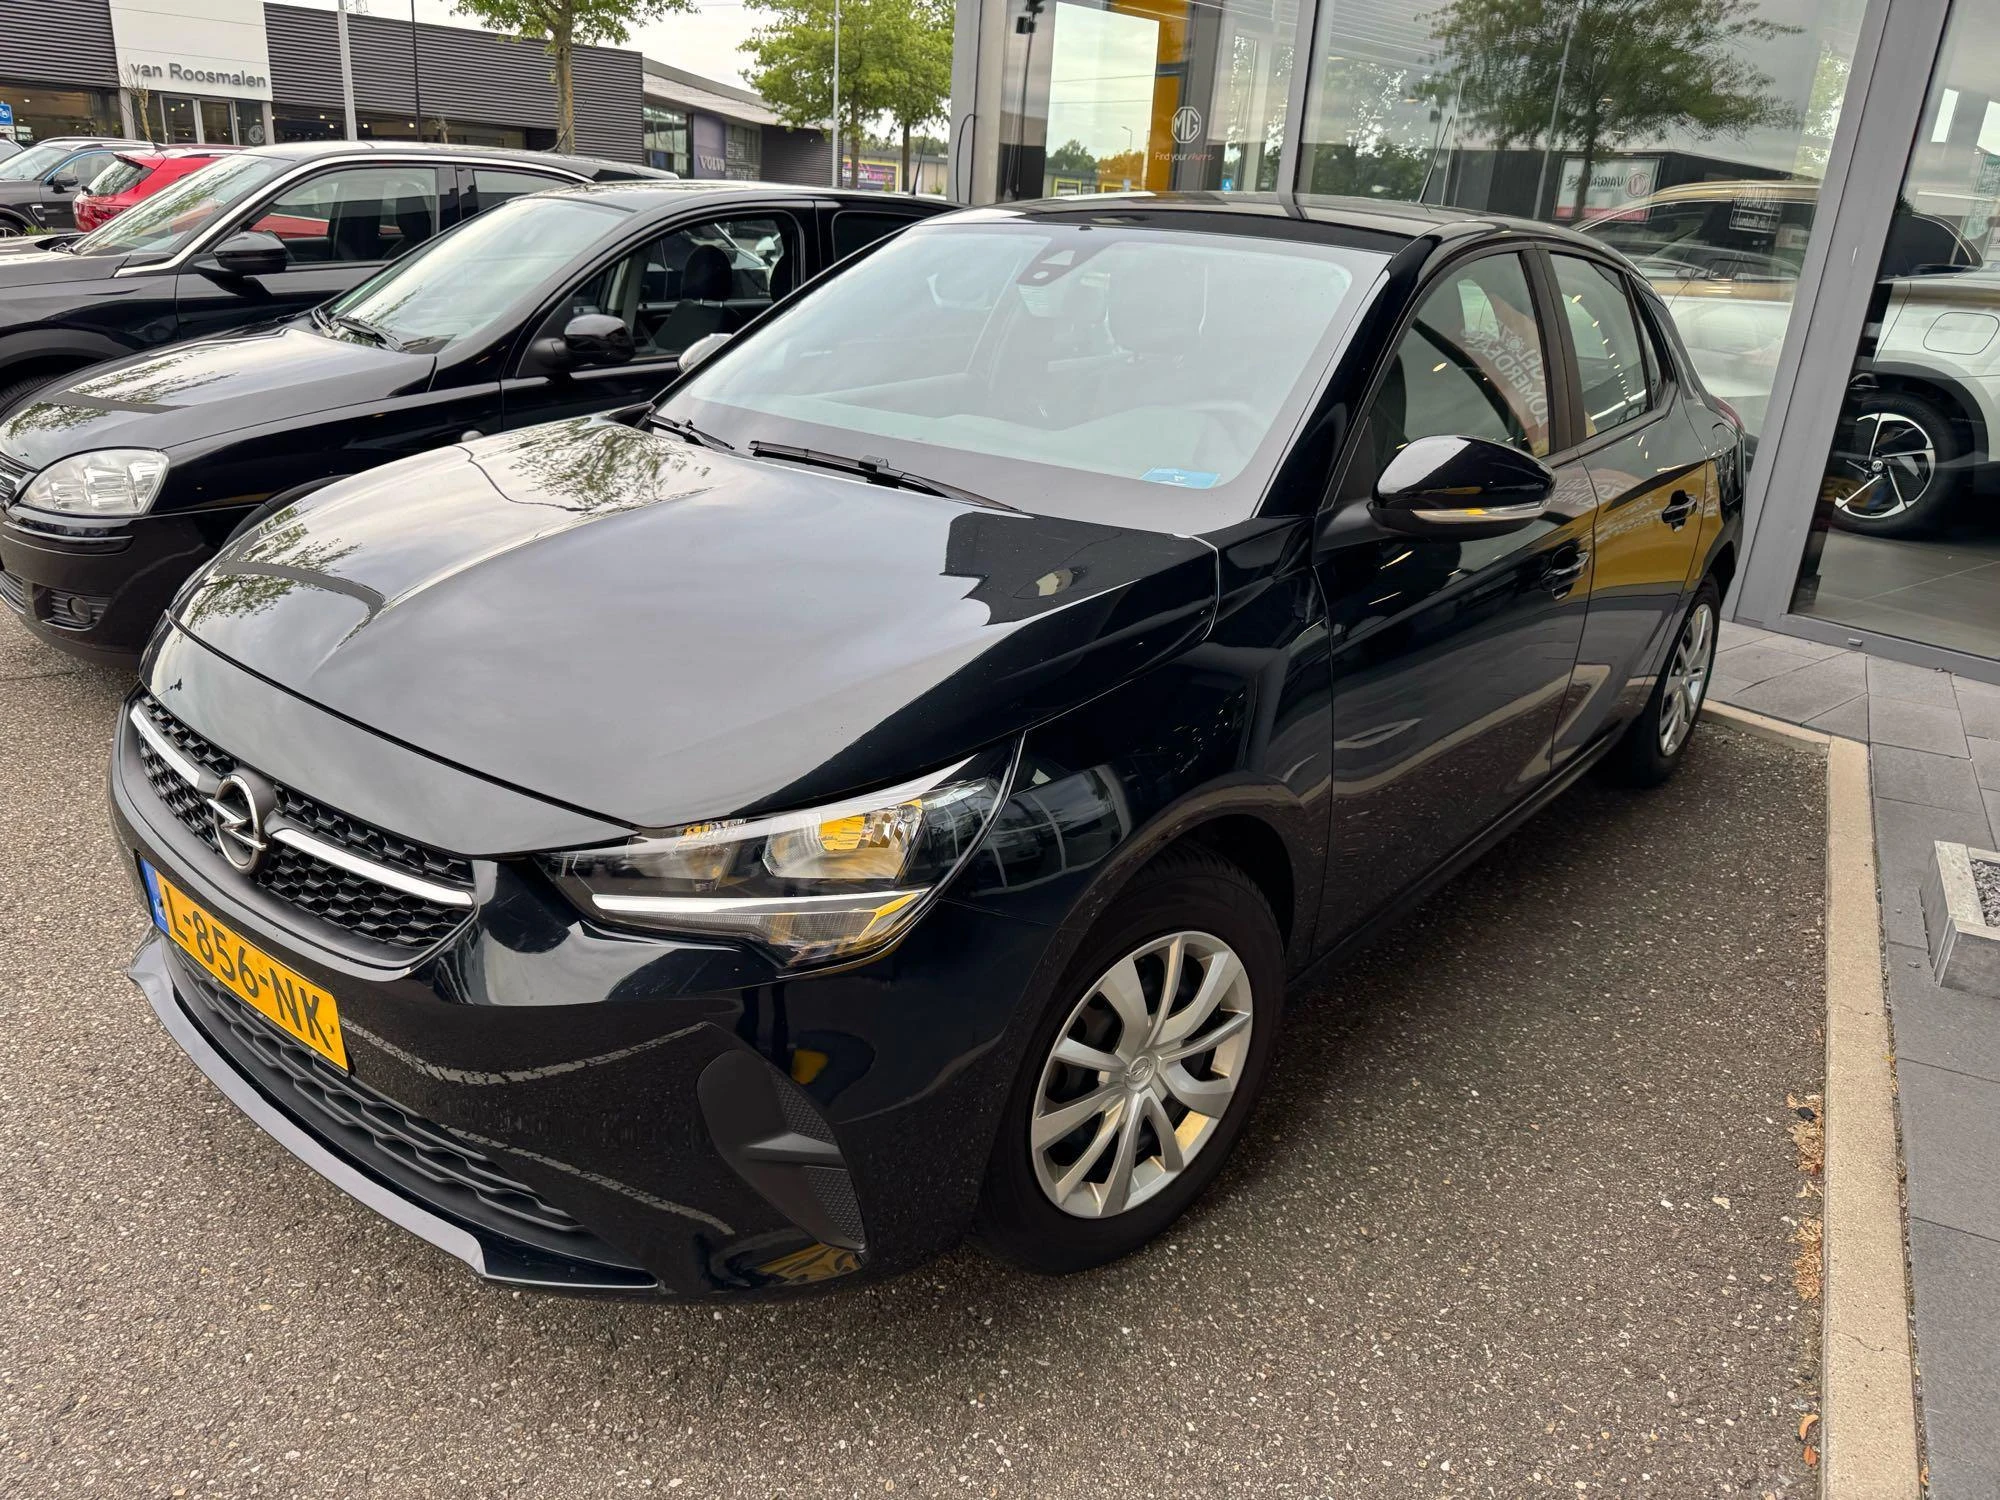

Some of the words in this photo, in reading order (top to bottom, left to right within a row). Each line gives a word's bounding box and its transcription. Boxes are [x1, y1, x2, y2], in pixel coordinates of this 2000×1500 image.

[130, 63, 163, 78] van
[168, 62, 267, 88] Roosmalen
[1173, 108, 1199, 141] MG
[699, 154, 726, 172] VOLVO
[1155, 151, 1170, 160] Find
[1171, 152, 1187, 163] your
[164, 884, 333, 1052] L-856-NK
